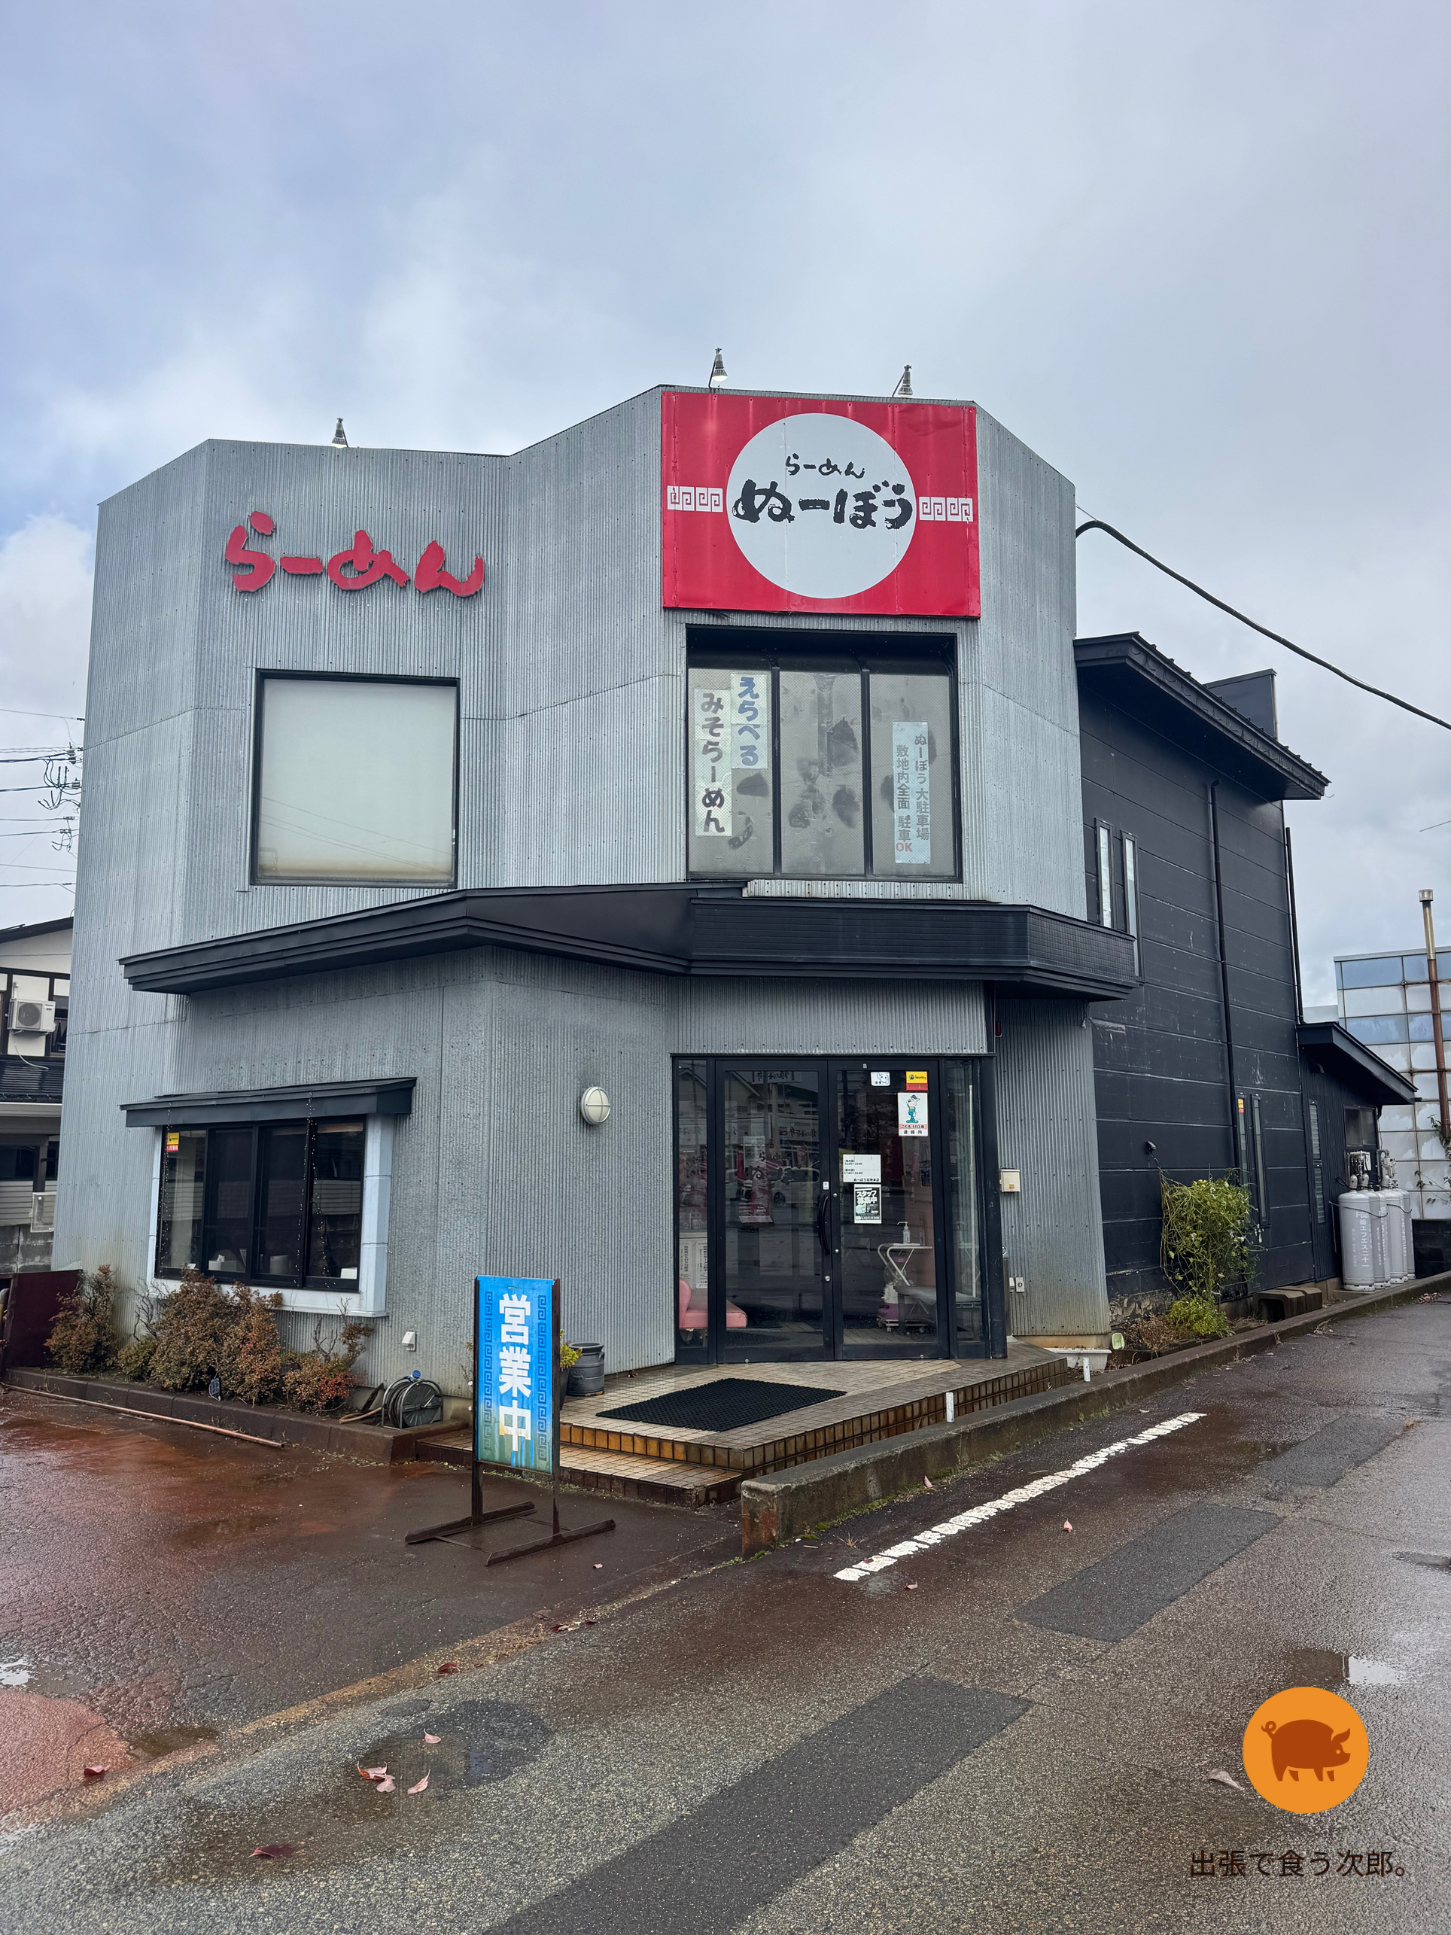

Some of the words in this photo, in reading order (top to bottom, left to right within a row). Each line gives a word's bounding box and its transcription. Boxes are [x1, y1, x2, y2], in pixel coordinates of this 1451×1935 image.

[732, 478, 914, 530] ぬーぼう
[785, 453, 866, 480] らーめん
[225, 510, 485, 598] らーめん
[701, 692, 725, 834] みそらーめん
[737, 676, 760, 767] えらべる
[498, 1293, 532, 1452] 営業中
